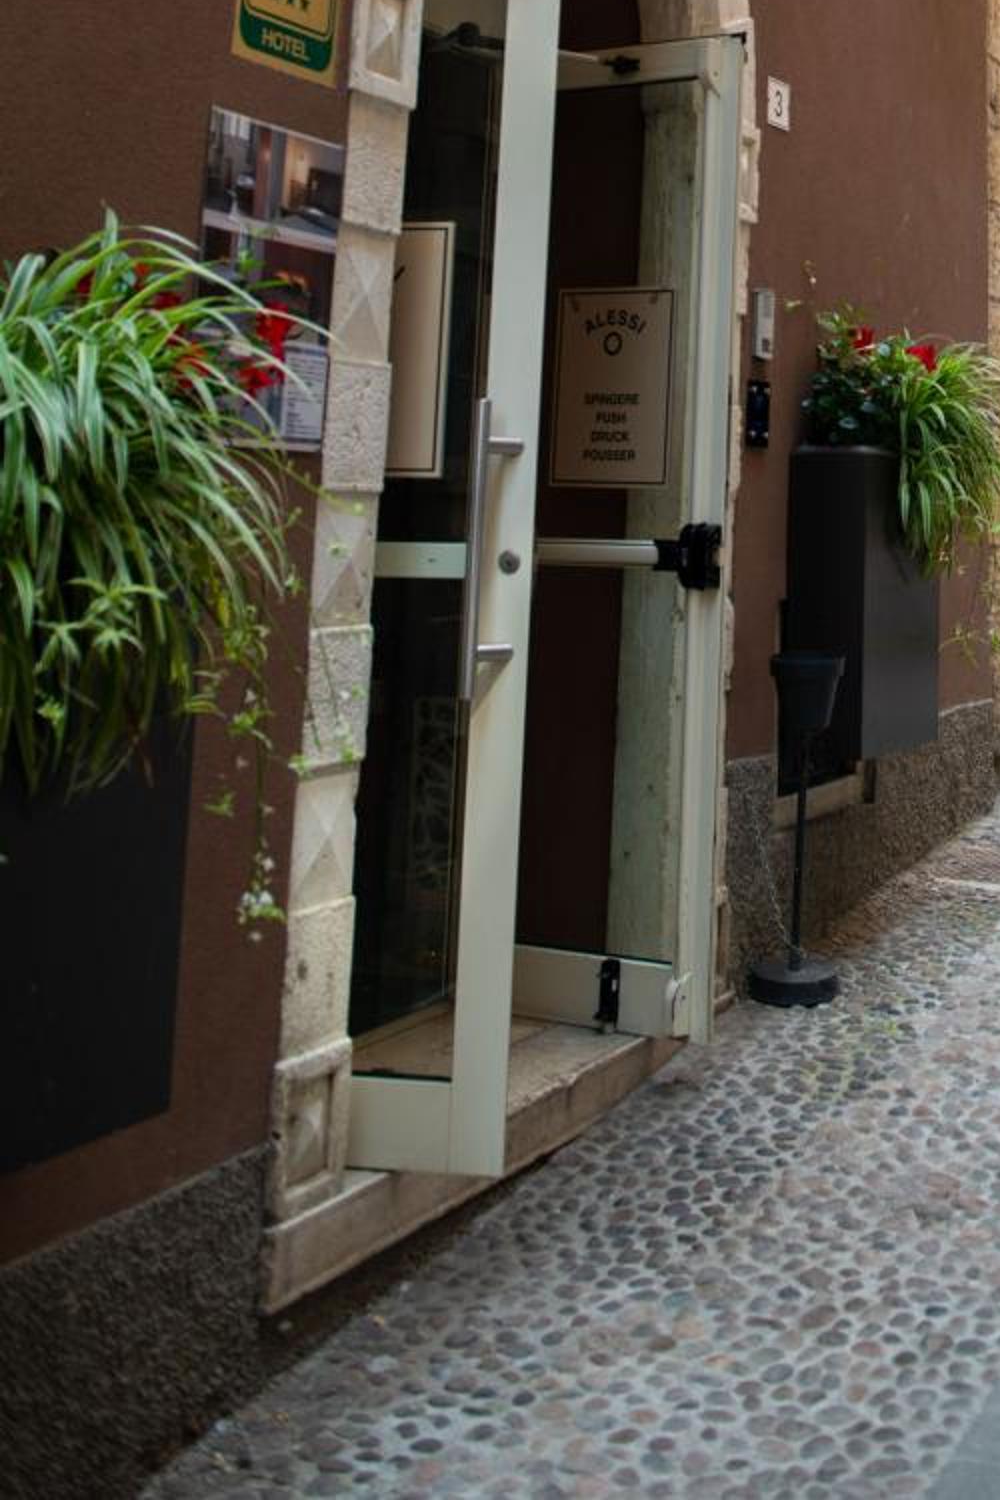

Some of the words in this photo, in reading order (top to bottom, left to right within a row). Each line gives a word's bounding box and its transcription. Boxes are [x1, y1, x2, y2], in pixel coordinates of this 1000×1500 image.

[260, 27, 310, 62] HOTEL
[774, 90, 783, 117] 3
[584, 309, 647, 336] ALESSI
